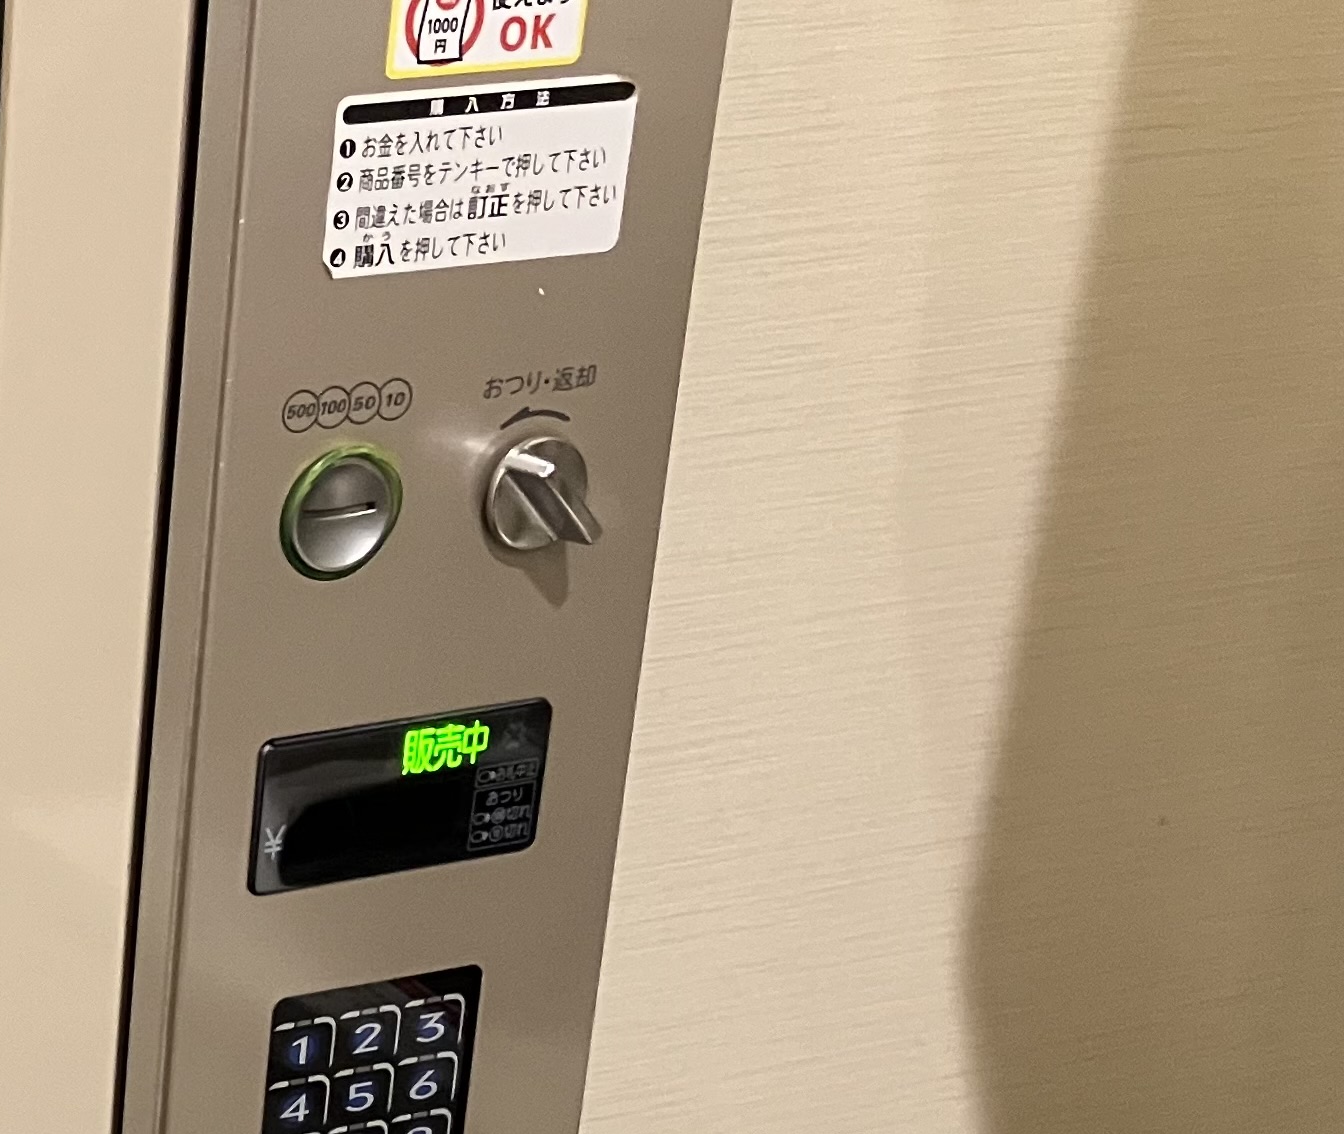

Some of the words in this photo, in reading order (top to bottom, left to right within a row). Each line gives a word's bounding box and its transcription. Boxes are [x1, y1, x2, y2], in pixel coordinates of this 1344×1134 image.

[427, 18, 459, 35] 1000
[499, 13, 557, 52] OK
[434, 38, 447, 54] 円
[429, 90, 551, 117] 購入方法
[360, 125, 504, 158] お金を入れて下さい
[358, 147, 607, 193] 商品番号をテンキーで押して下さい
[483, 365, 598, 400] おつり・返却
[286, 401, 316, 419] 500
[320, 398, 347, 415] 100
[353, 395, 376, 411] 50
[386, 391, 406, 407] 10
[401, 719, 490, 776] 販売中
[263, 825, 287, 860] ¥
[291, 1035, 309, 1065] 1
[352, 1022, 381, 1054] 2
[416, 1011, 445, 1042] 3
[279, 1093, 310, 1122] 4
[345, 1081, 374, 1111] 5
[409, 1069, 438, 1100] 6
